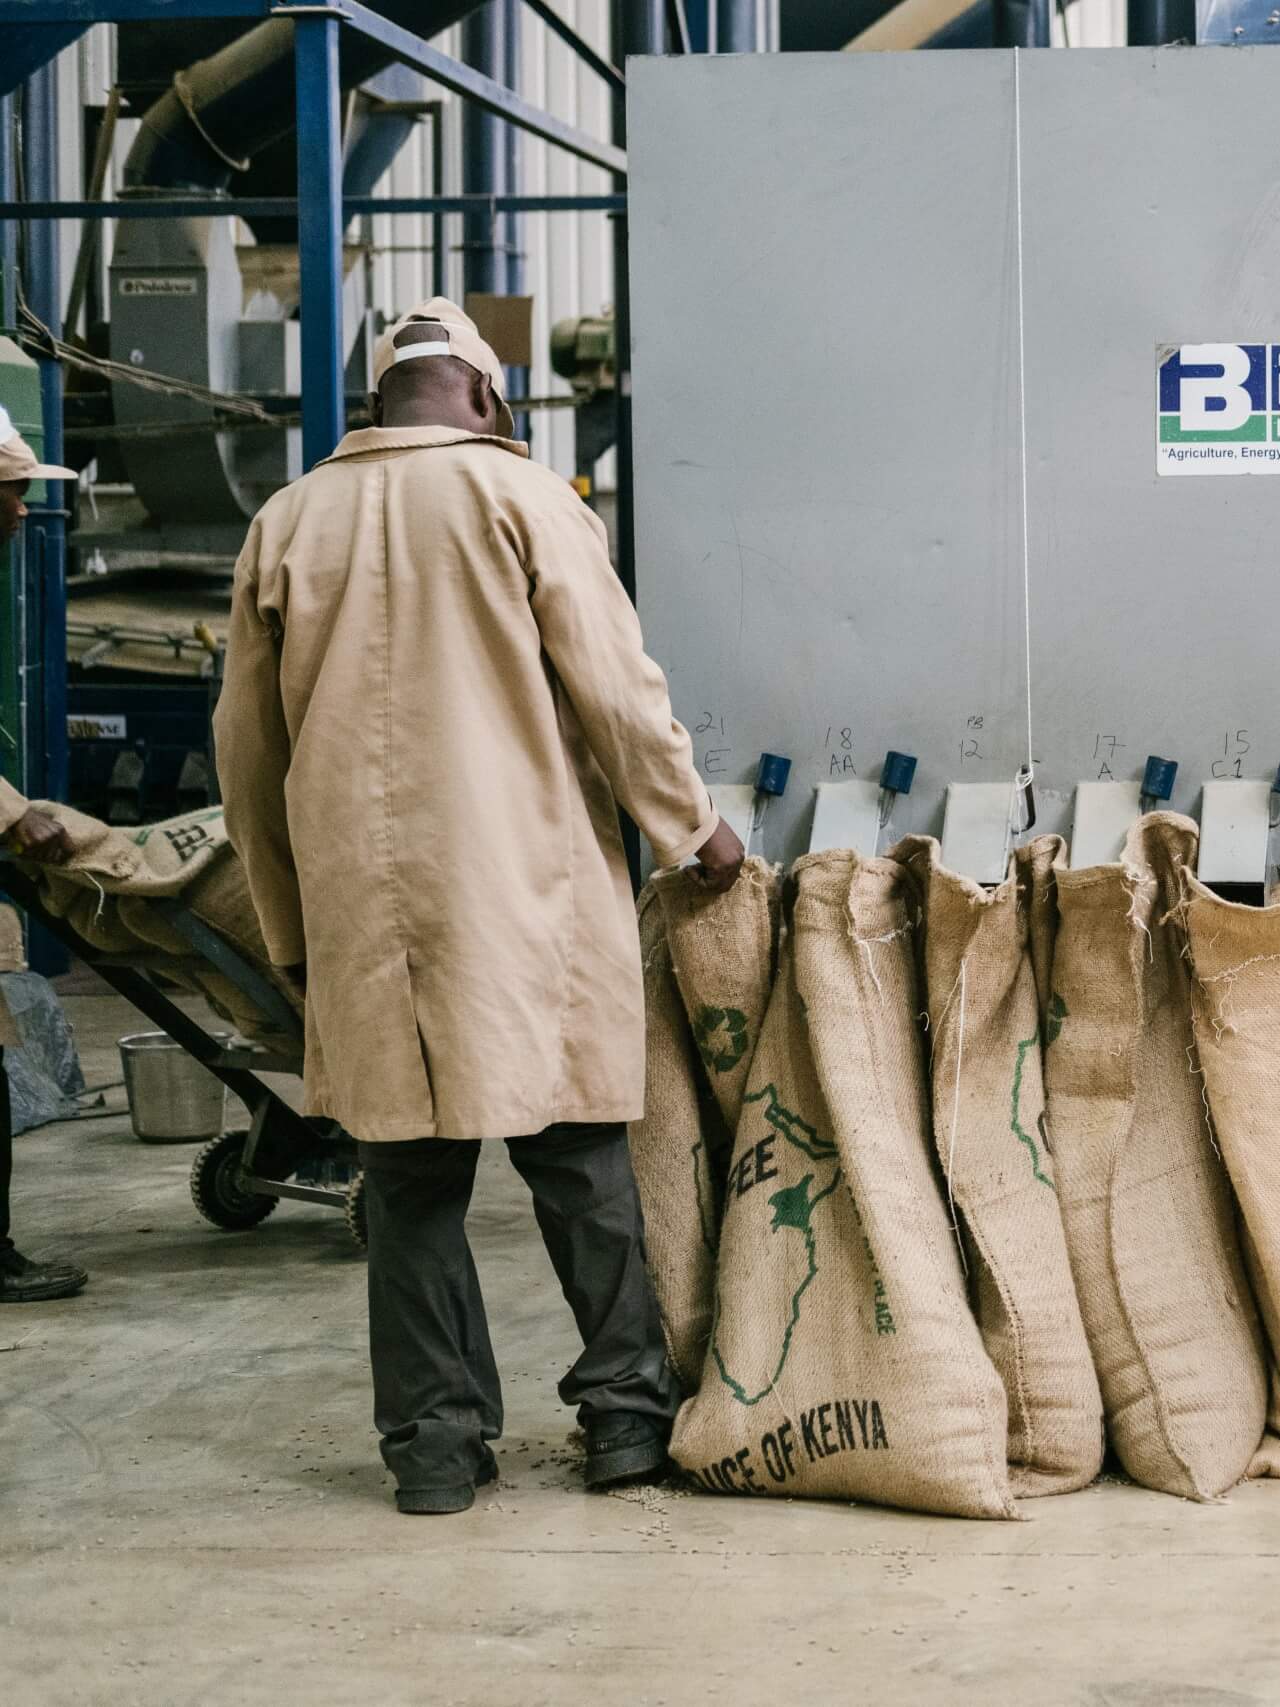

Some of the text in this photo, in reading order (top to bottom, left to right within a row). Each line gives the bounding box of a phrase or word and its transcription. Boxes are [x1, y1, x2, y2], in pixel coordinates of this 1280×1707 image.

[1180, 345, 1252, 432] B
[696, 712, 724, 735] 21
[825, 727, 852, 749] 18
[1094, 734, 1126, 758] 17
[1224, 730, 1250, 755] 15
[704, 749, 731, 773] E
[960, 739, 983, 763] 12
[829, 754, 857, 776] AA
[1098, 761, 1113, 780] A
[761, 1415, 795, 1483] OF
[800, 1399, 890, 1463] KENYA
